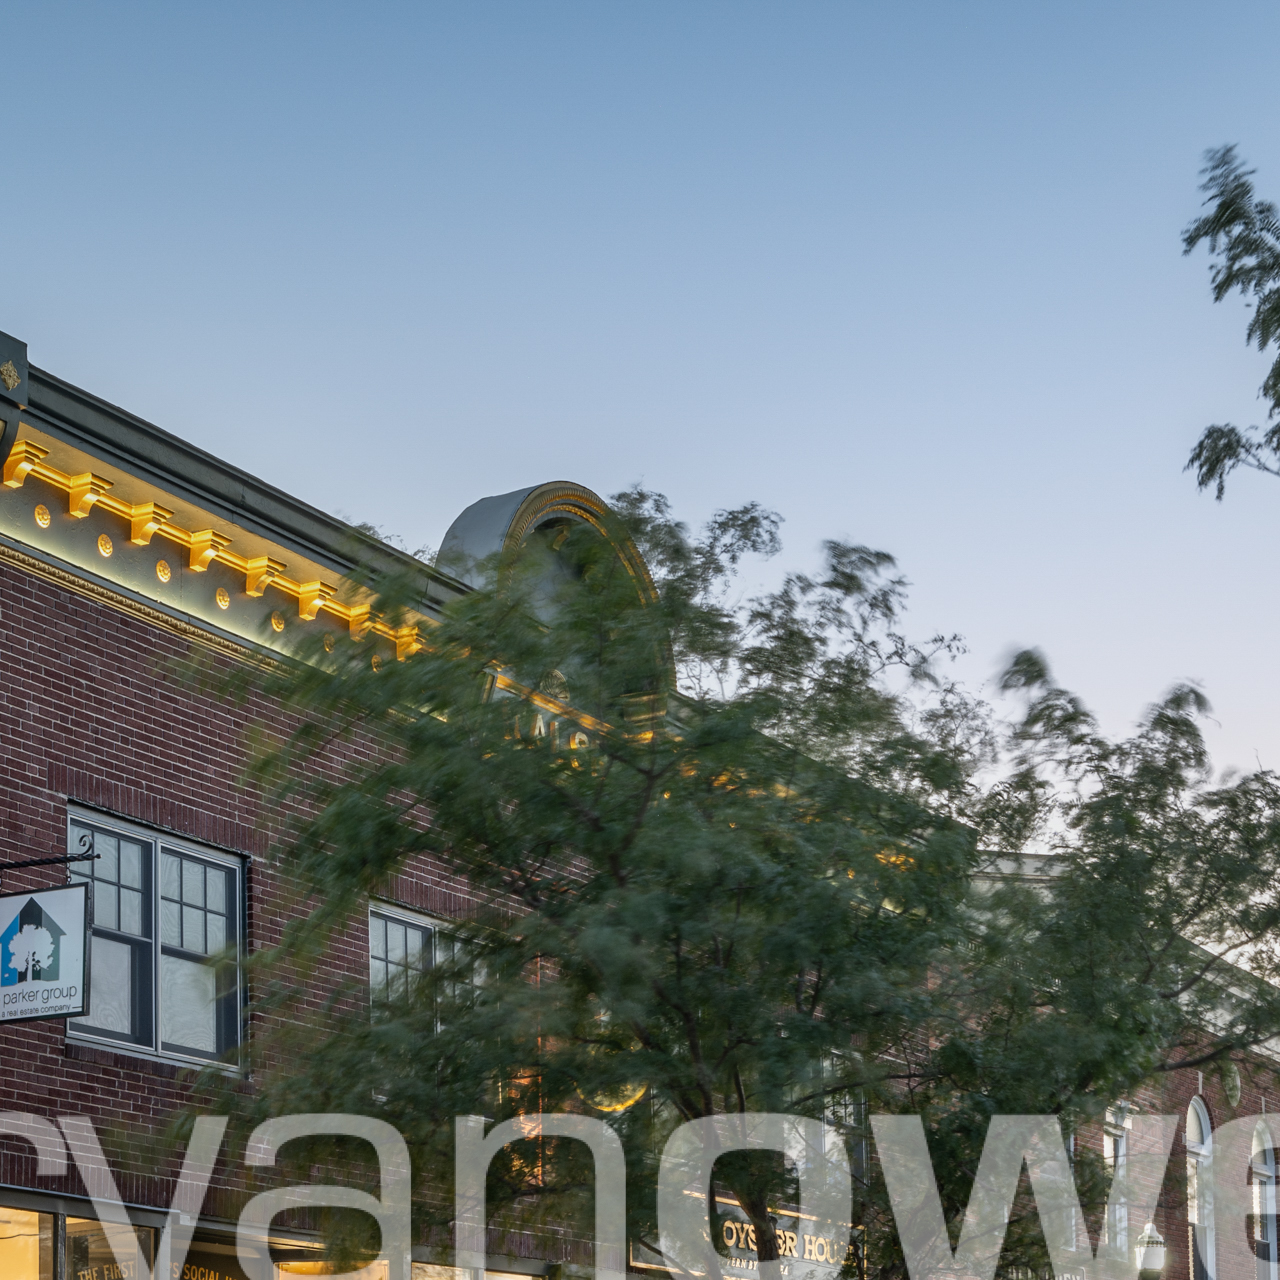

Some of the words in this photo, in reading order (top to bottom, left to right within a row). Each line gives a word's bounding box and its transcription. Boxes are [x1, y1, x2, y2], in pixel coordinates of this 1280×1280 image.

[3, 989, 39, 1008] parker
[41, 985, 77, 1004] group
[7, 1009, 18, 1017] real
[20, 1007, 39, 1016] estate
[41, 1004, 71, 1014] company
[723, 1220, 799, 1258] OYSER
[103, 1260, 135, 1280] FIRST
